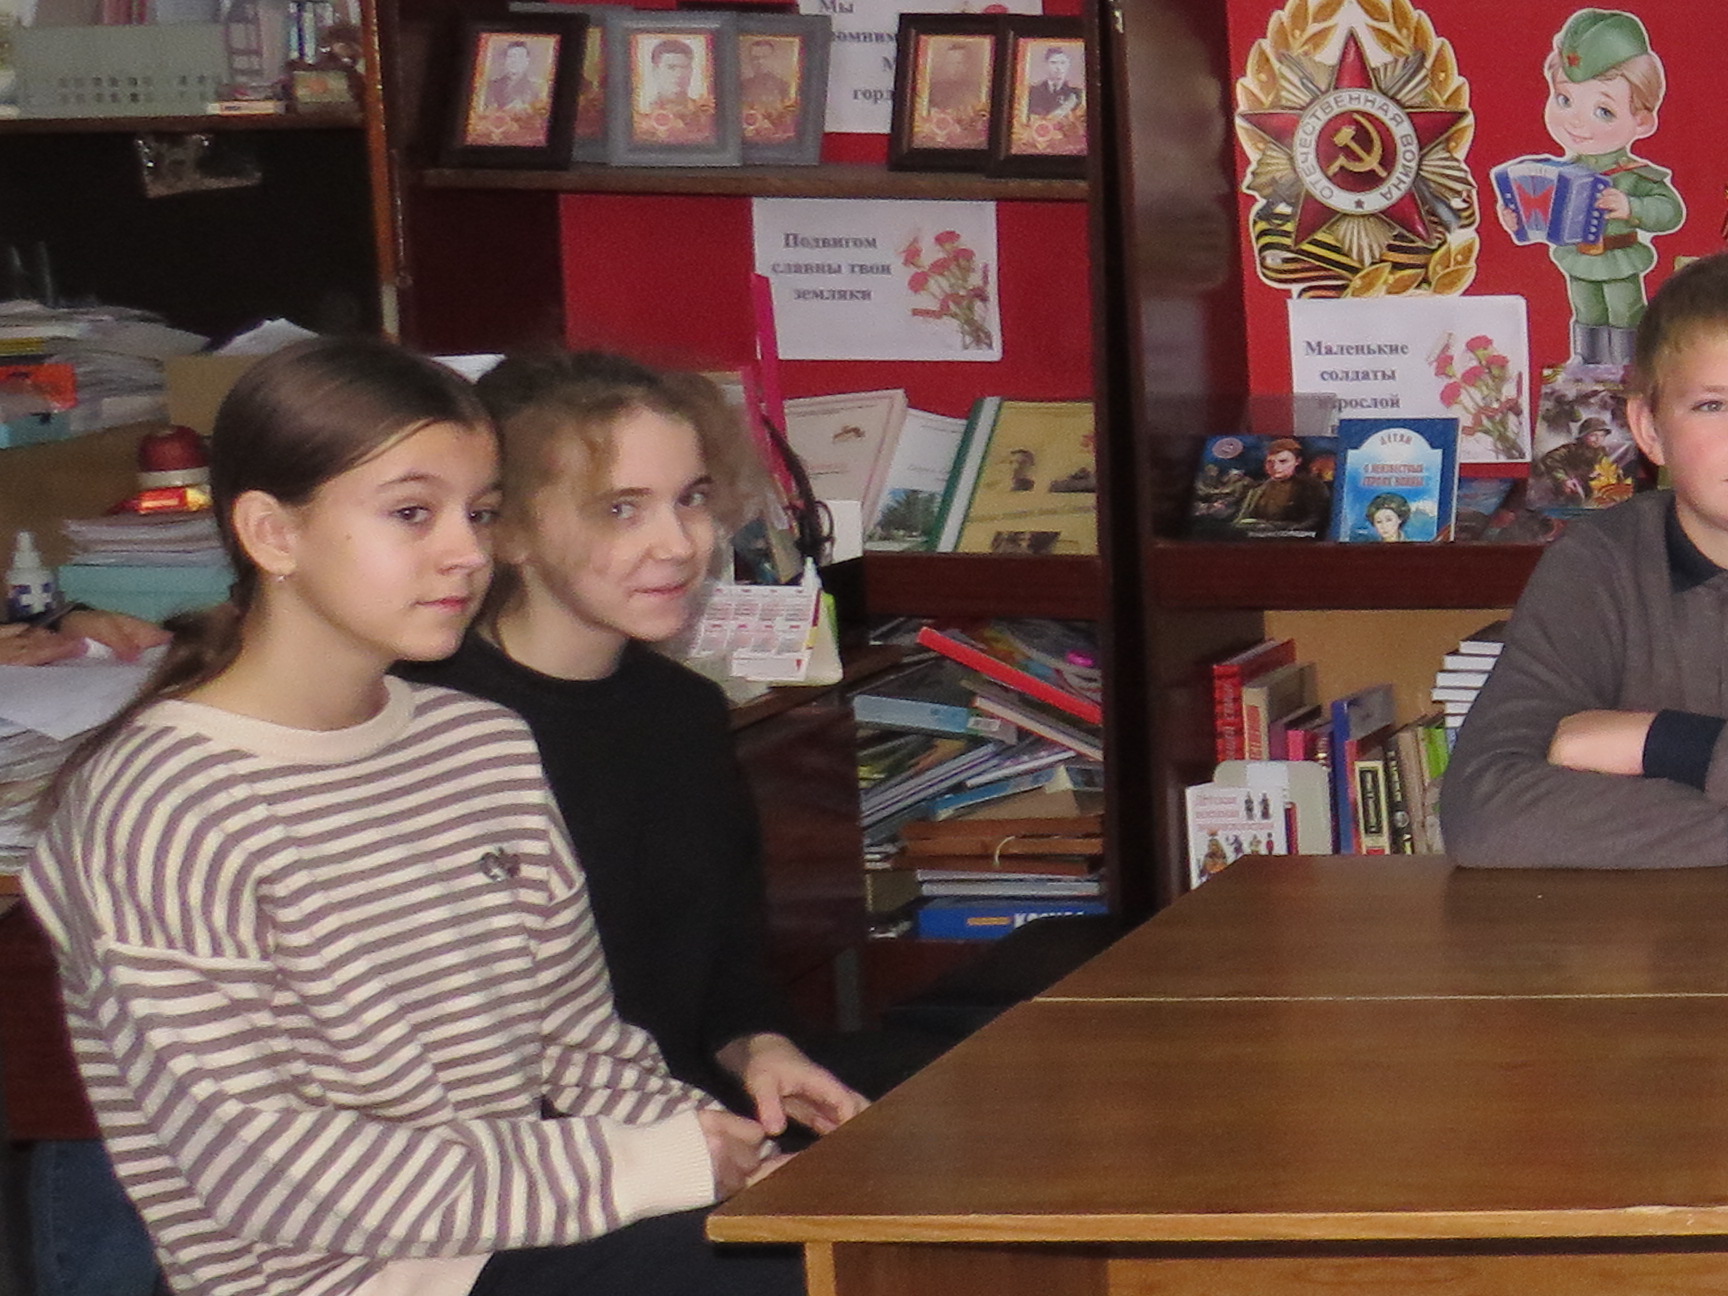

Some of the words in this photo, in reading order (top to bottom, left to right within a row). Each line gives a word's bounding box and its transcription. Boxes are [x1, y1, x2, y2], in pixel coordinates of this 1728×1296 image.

[831, 30, 898, 44] омним
[1299, 93, 1405, 200] ОТЕЧЕСТВЕННАЯ
[1380, 132, 1417, 202] ВОЙНА
[783, 232, 878, 250] Подвигом
[771, 261, 842, 276] славны
[848, 261, 892, 275] твои
[793, 287, 872, 302] земляки
[1305, 340, 1410, 356] Маленькие
[1320, 367, 1397, 382] солдаты
